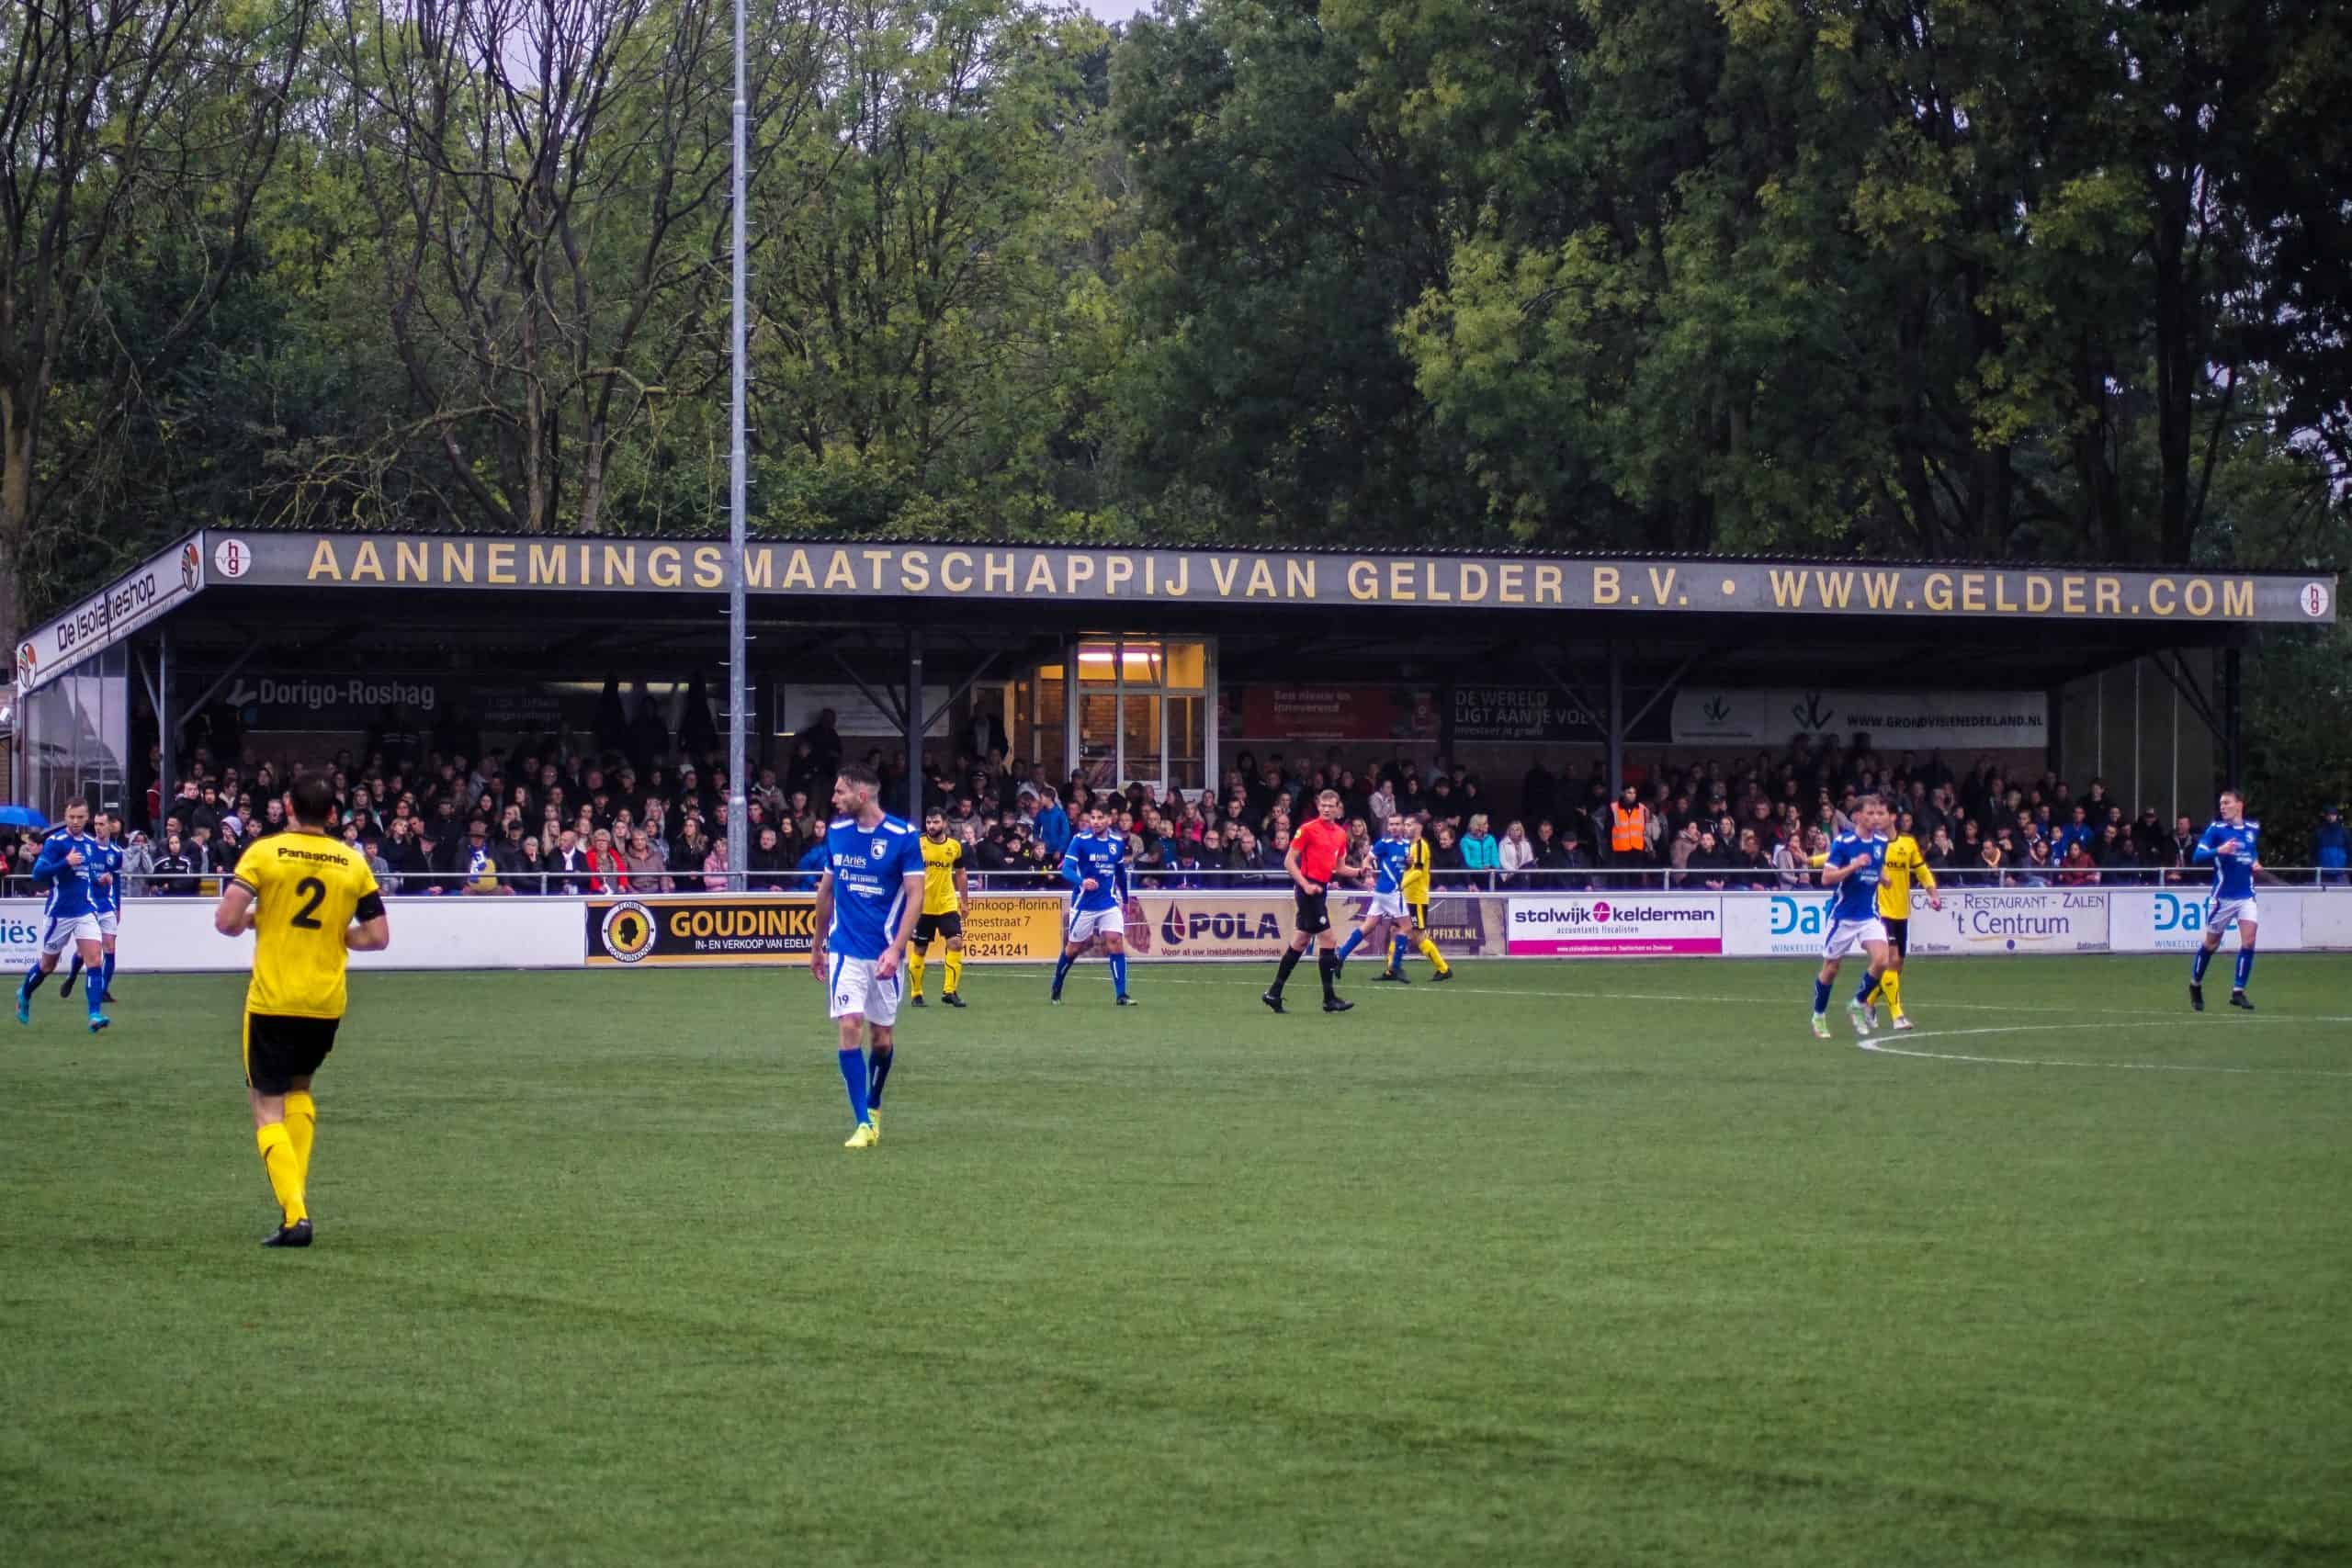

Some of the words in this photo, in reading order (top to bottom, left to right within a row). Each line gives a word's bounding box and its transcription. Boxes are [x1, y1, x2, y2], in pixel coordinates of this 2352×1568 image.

[1210, 558, 1316, 598] VAN
[1348, 560, 1562, 603] GELDER
[1593, 567, 1687, 604] B.V.
[1770, 570, 2254, 616] WWW.GELDER.COM
[57, 624, 75, 652] De
[76, 572, 156, 641] Isolatieshop
[259, 679, 435, 710] Dorigo-Roshag
[1455, 691, 1477, 706] DE
[1481, 691, 1549, 706] WERELD
[1455, 707, 1492, 724] LIGT
[1497, 707, 1531, 724] AAN
[278, 848, 348, 865] Panasonic
[291, 876, 326, 930] 2
[967, 897, 1062, 911] dinkoop-florin.nl
[1964, 893, 2047, 909] RESTAURANT
[2063, 892, 2104, 908] ZALEN
[961, 917, 1021, 927] amsestraat
[1024, 916, 1031, 927] 7
[1515, 908, 1590, 925] stolwijk
[1613, 907, 1714, 921] kelderman
[1973, 910, 2069, 934] Centrum
[1189, 912, 1281, 940] POLA
[1556, 926, 1599, 934] accountants
[1601, 925, 1639, 934] fiscalisten
[695, 940, 707, 950] IN-
[709, 940, 721, 949] EN
[723, 939, 763, 949] VERKOOP
[765, 939, 781, 949] VAN
[962, 931, 1012, 942] Zevenaar
[964, 944, 1028, 956] 16-241241
[1206, 947, 1281, 956] installatietechniek
[838, 994, 849, 1006] 19
